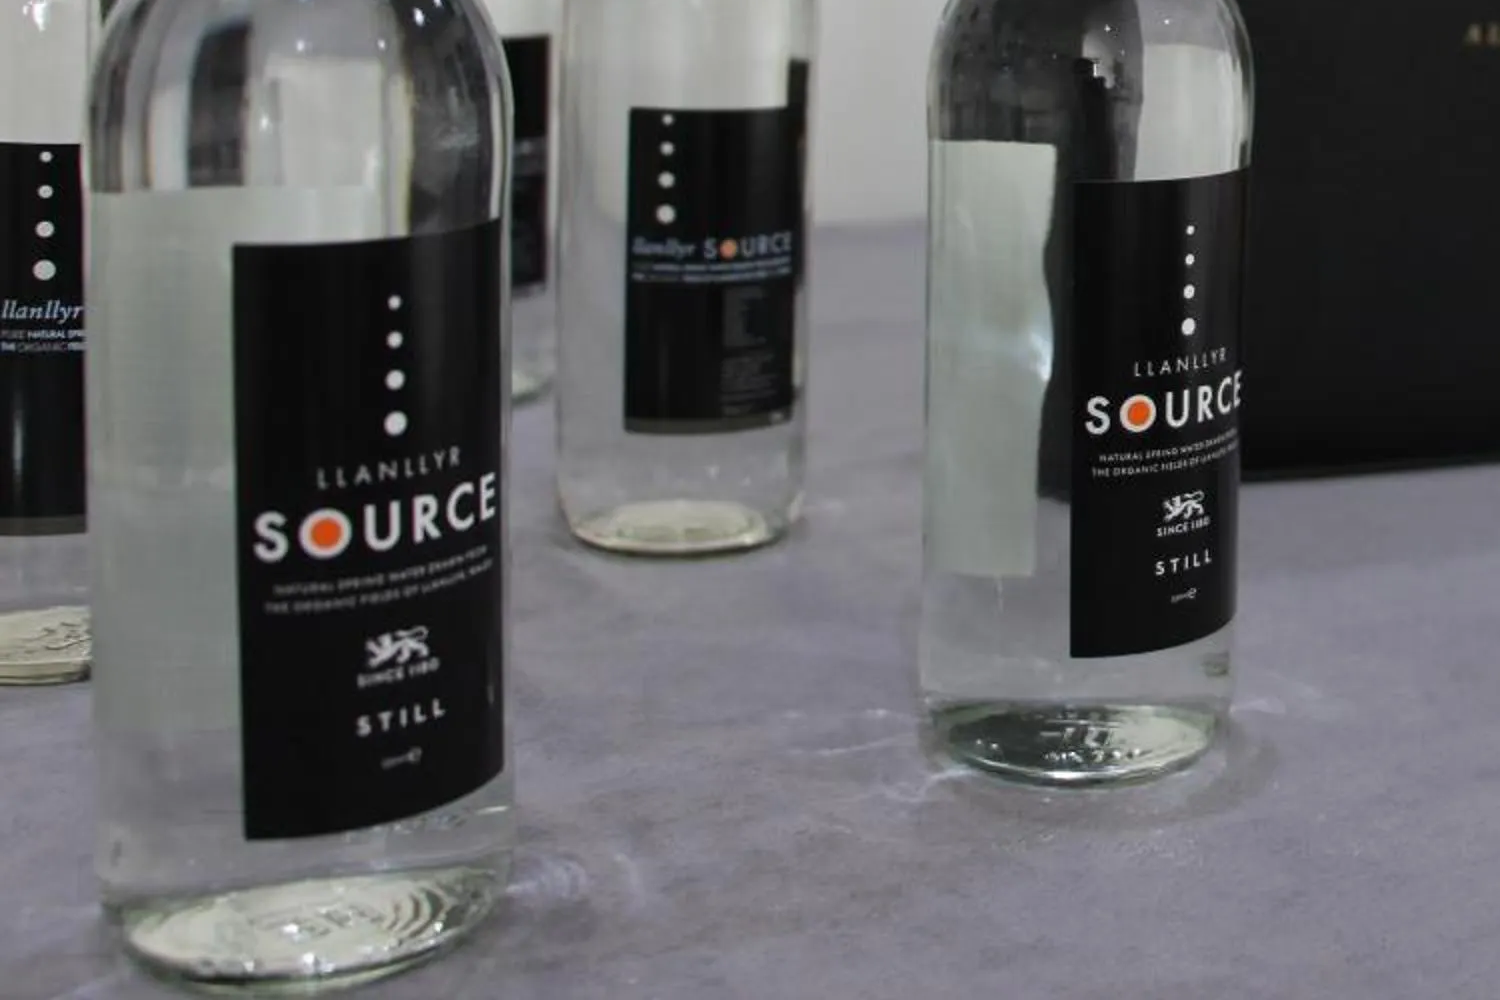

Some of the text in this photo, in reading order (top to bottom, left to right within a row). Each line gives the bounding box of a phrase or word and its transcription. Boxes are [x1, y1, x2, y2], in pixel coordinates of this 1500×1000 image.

[703, 231, 792, 261] SOURCE
[1, 299, 84, 325] llanllyr
[1133, 346, 1227, 378] LLANLLYR
[1085, 370, 1243, 435] SOURCE
[317, 445, 462, 491] LLANLLYR
[1092, 466, 1110, 478] THE
[1112, 463, 1159, 477] ORGANIC
[253, 472, 497, 564] SOURCE
[1156, 521, 1190, 538] SINCE
[1155, 548, 1213, 576] STILL
[357, 665, 405, 689] SINCE
[356, 697, 446, 738] STILL
